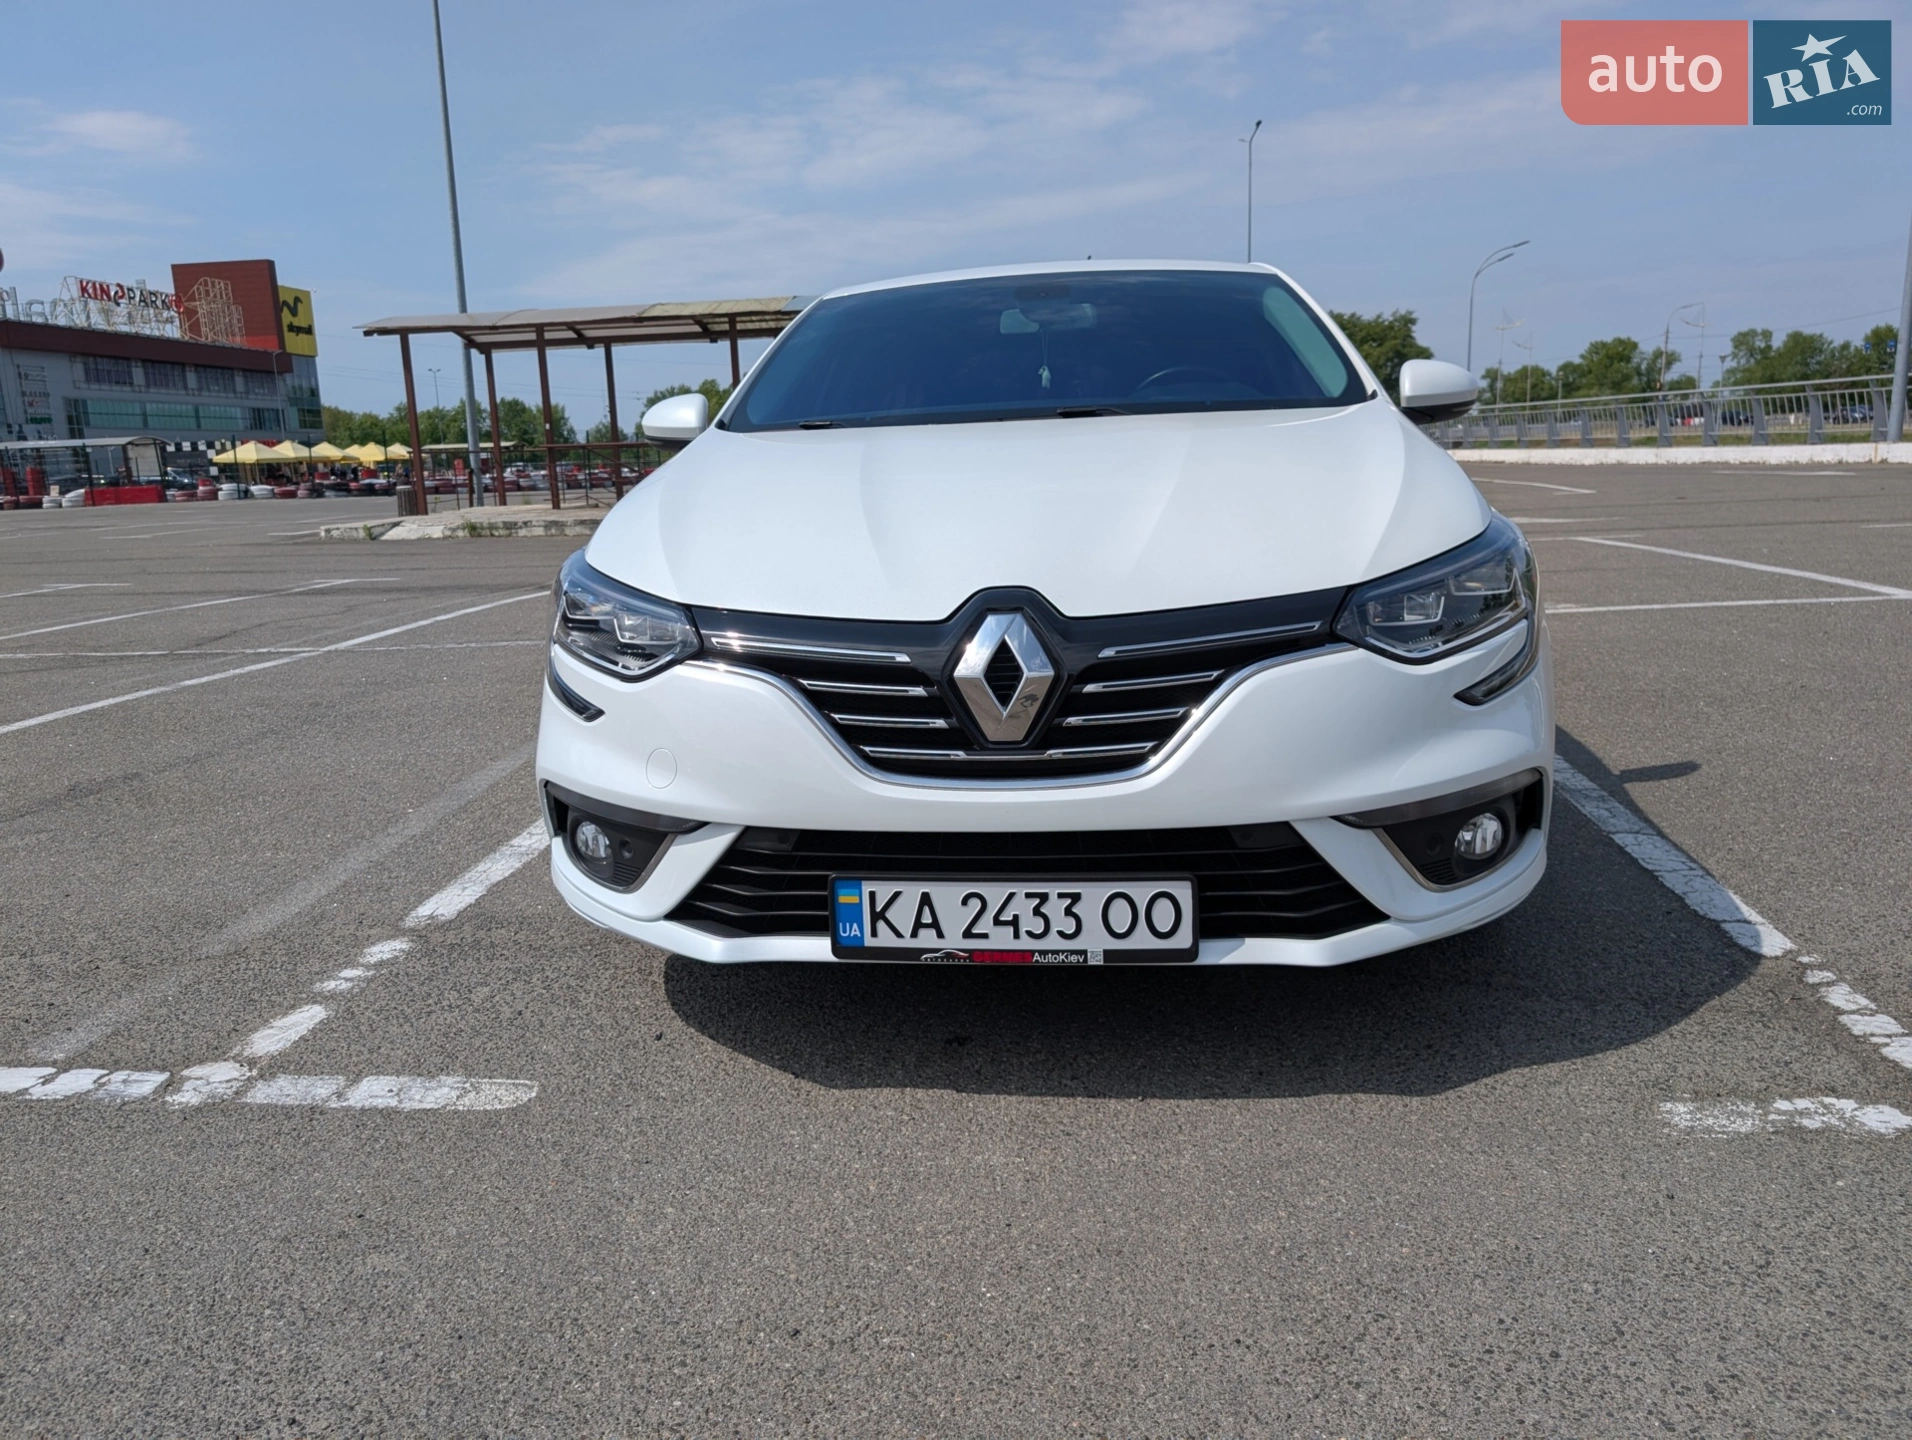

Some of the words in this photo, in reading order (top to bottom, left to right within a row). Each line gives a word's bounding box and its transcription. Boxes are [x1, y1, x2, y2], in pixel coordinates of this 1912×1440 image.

[839, 922, 861, 937] UA
[867, 889, 946, 939] KA
[960, 889, 1083, 940] 2433
[1100, 889, 1183, 940] OO
